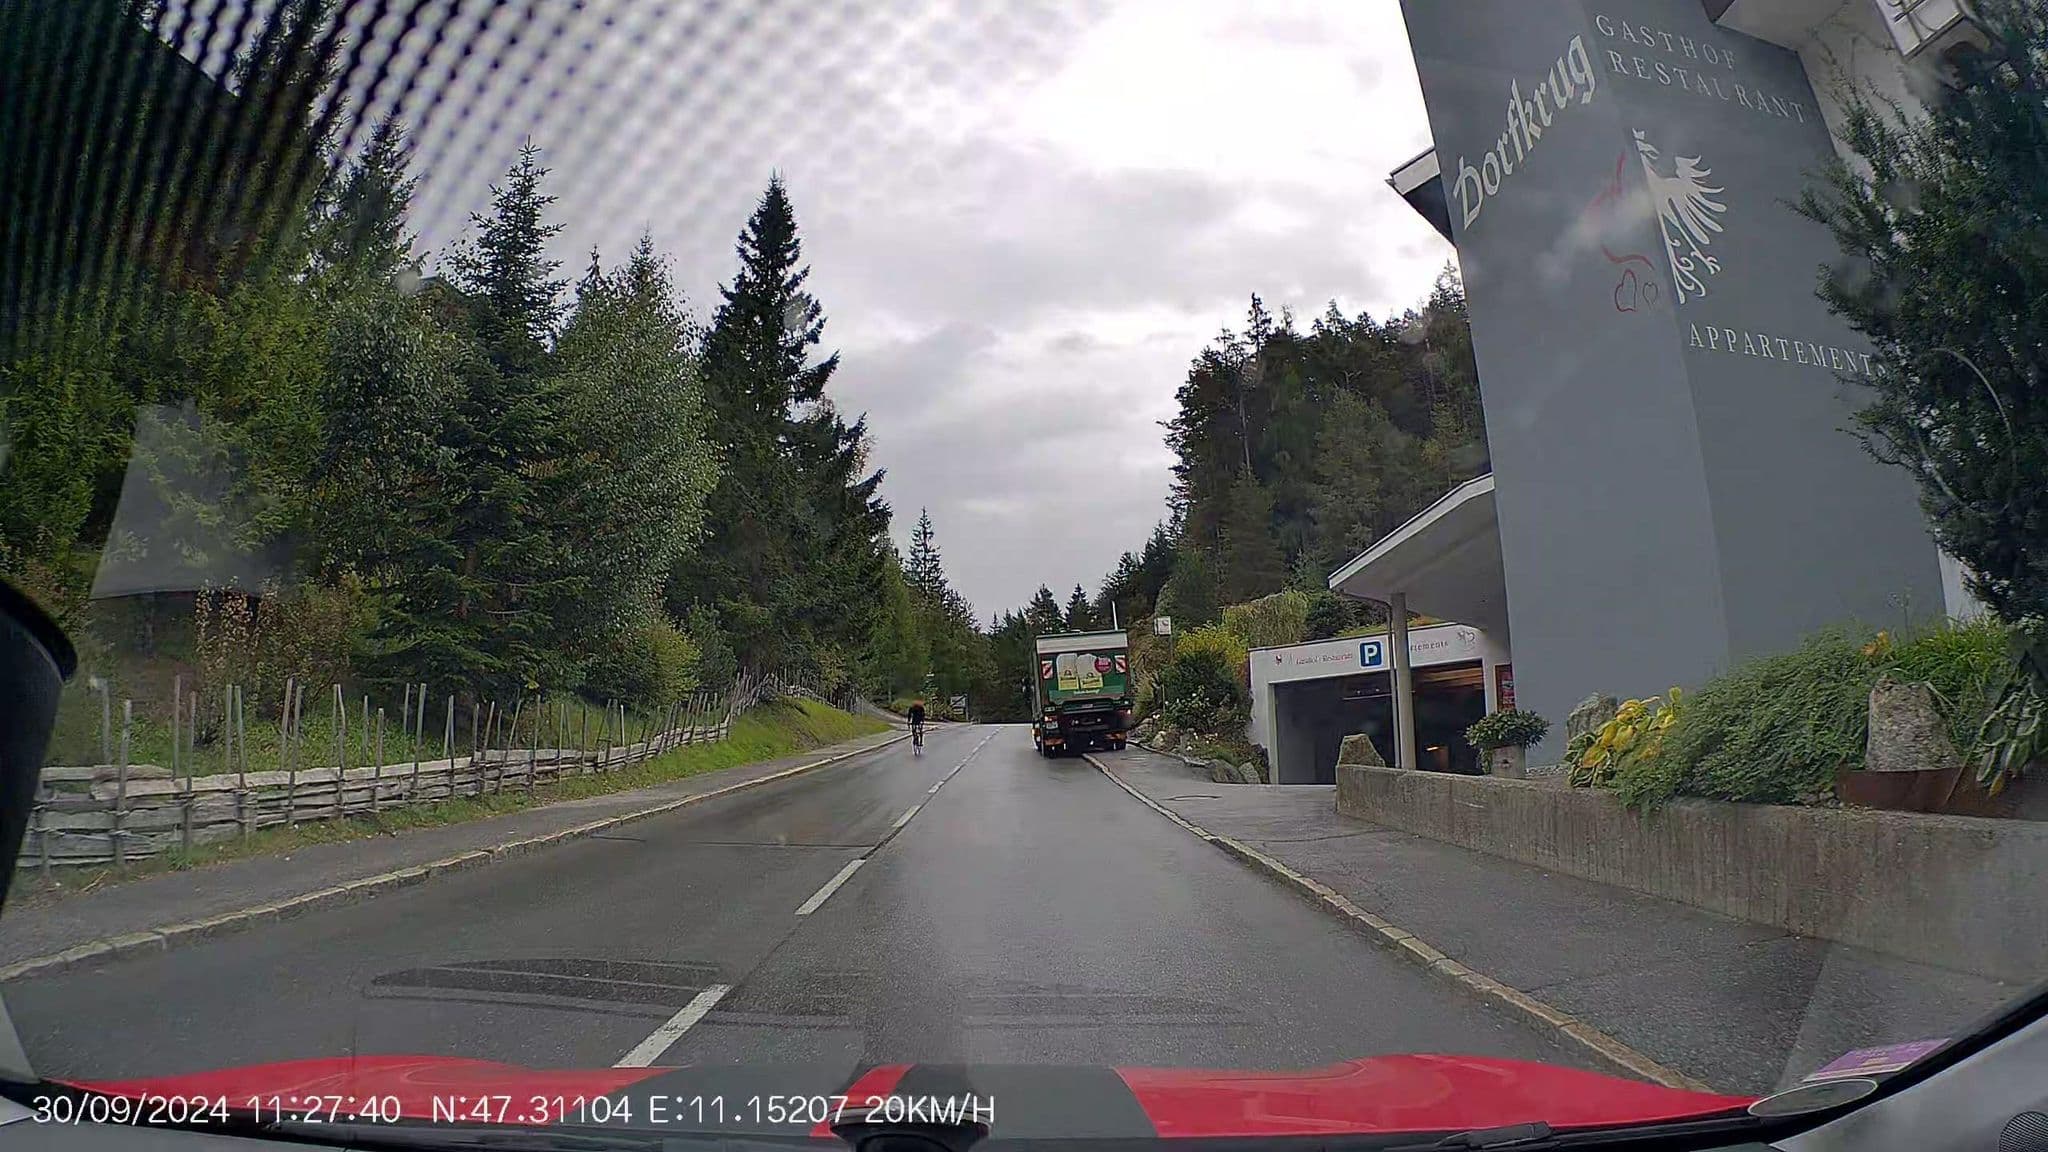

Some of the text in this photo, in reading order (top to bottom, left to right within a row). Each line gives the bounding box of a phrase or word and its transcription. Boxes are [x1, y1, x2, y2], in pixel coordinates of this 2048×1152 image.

[1596, 15, 1735, 70] GASTHOF
[1608, 50, 1804, 124] RESTAURANT
[1453, 34, 1596, 231] Dorfkrug
[1363, 644, 1378, 665] P
